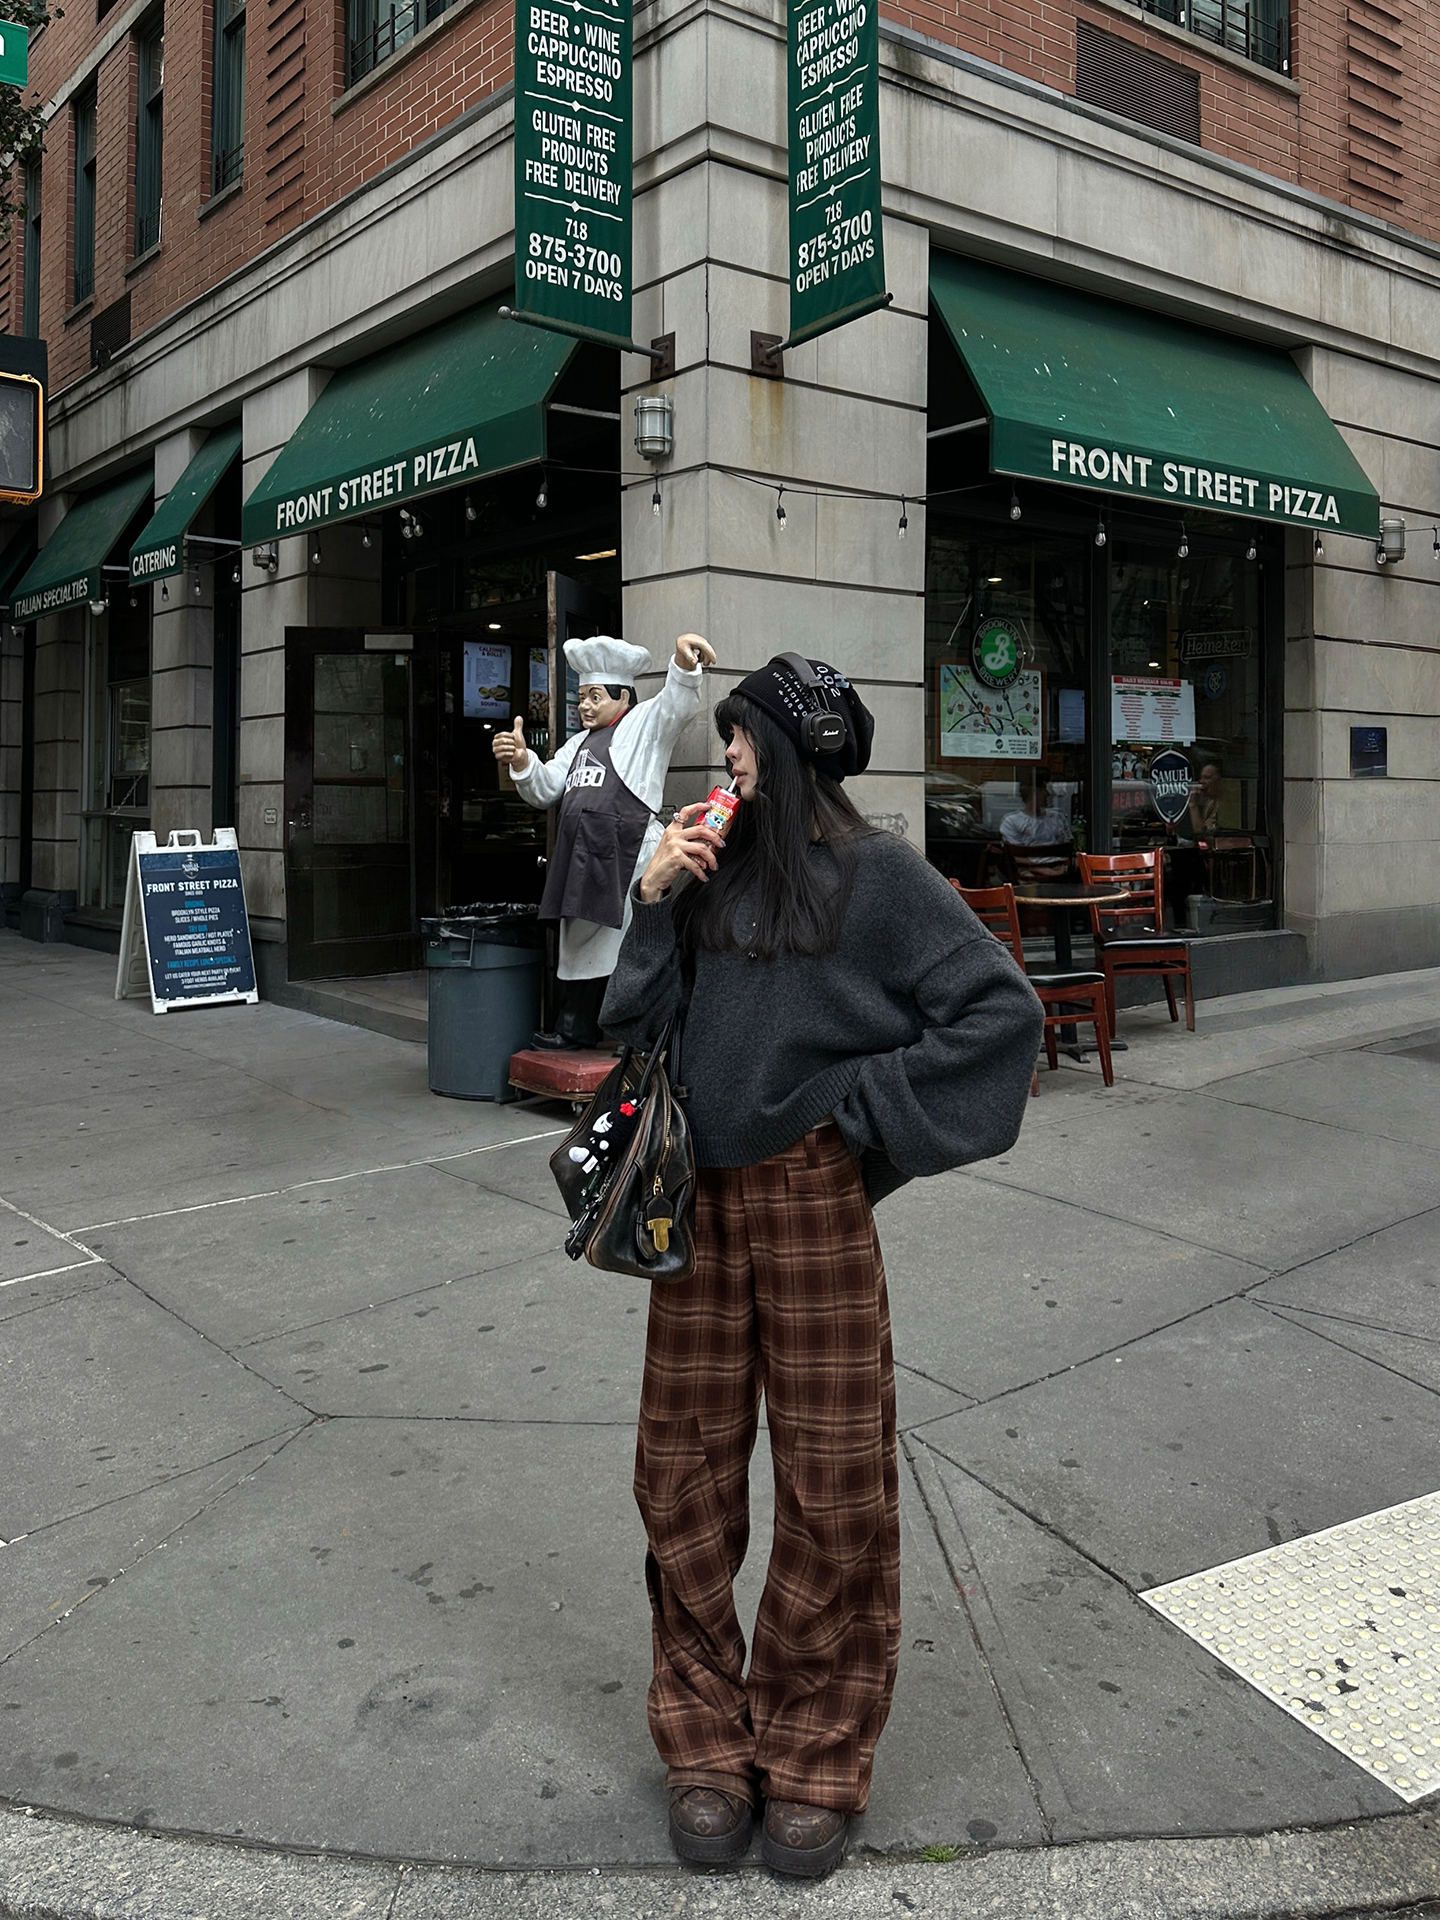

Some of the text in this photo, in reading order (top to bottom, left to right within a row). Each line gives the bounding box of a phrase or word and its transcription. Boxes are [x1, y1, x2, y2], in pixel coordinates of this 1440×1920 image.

[530, 6, 620, 55] BEER WINE
[796, 4, 867, 67] CAPPUCCINO
[797, 6, 825, 42] BEER
[528, 32, 622, 80] CAPPUCCINO
[801, 36, 859, 91] ESPRESSO
[537, 60, 613, 103] ESPRESSO
[532, 109, 616, 153] GLUTEN FREE
[799, 83, 864, 140] GLUTEN FREE
[542, 137, 608, 175] PRODUCTS
[806, 115, 856, 164] PRODUCTS
[526, 159, 621, 206] FREE DELIVERY
[796, 134, 871, 196] FREE DELIVERY
[565, 217, 588, 241] 718
[825, 200, 842, 226] 718
[529, 232, 622, 278] 875-3700
[798, 209, 872, 268] 875-3700
[525, 259, 623, 302] OPEN 7 DAYS
[796, 238, 875, 293] OPEN 7 DAYS
[276, 437, 479, 530] FRONT STREET PIZZA
[1052, 439, 1340, 524] FRONT STREET PIZZA
[132, 545, 176, 577] CATERING
[14, 577, 89, 618] ITALIAN SPECIALTIES
[979, 619, 1018, 641] BROOKLYN
[1187, 635, 1246, 655] Heineken
[980, 666, 1019, 687] BREWERY
[1151, 767, 1192, 785] SAMUEL
[1156, 781, 1189, 799] ADAMS
[147, 878, 238, 894] FRONT STREET PIZZA
[208, 906, 221, 914] PIZZA
